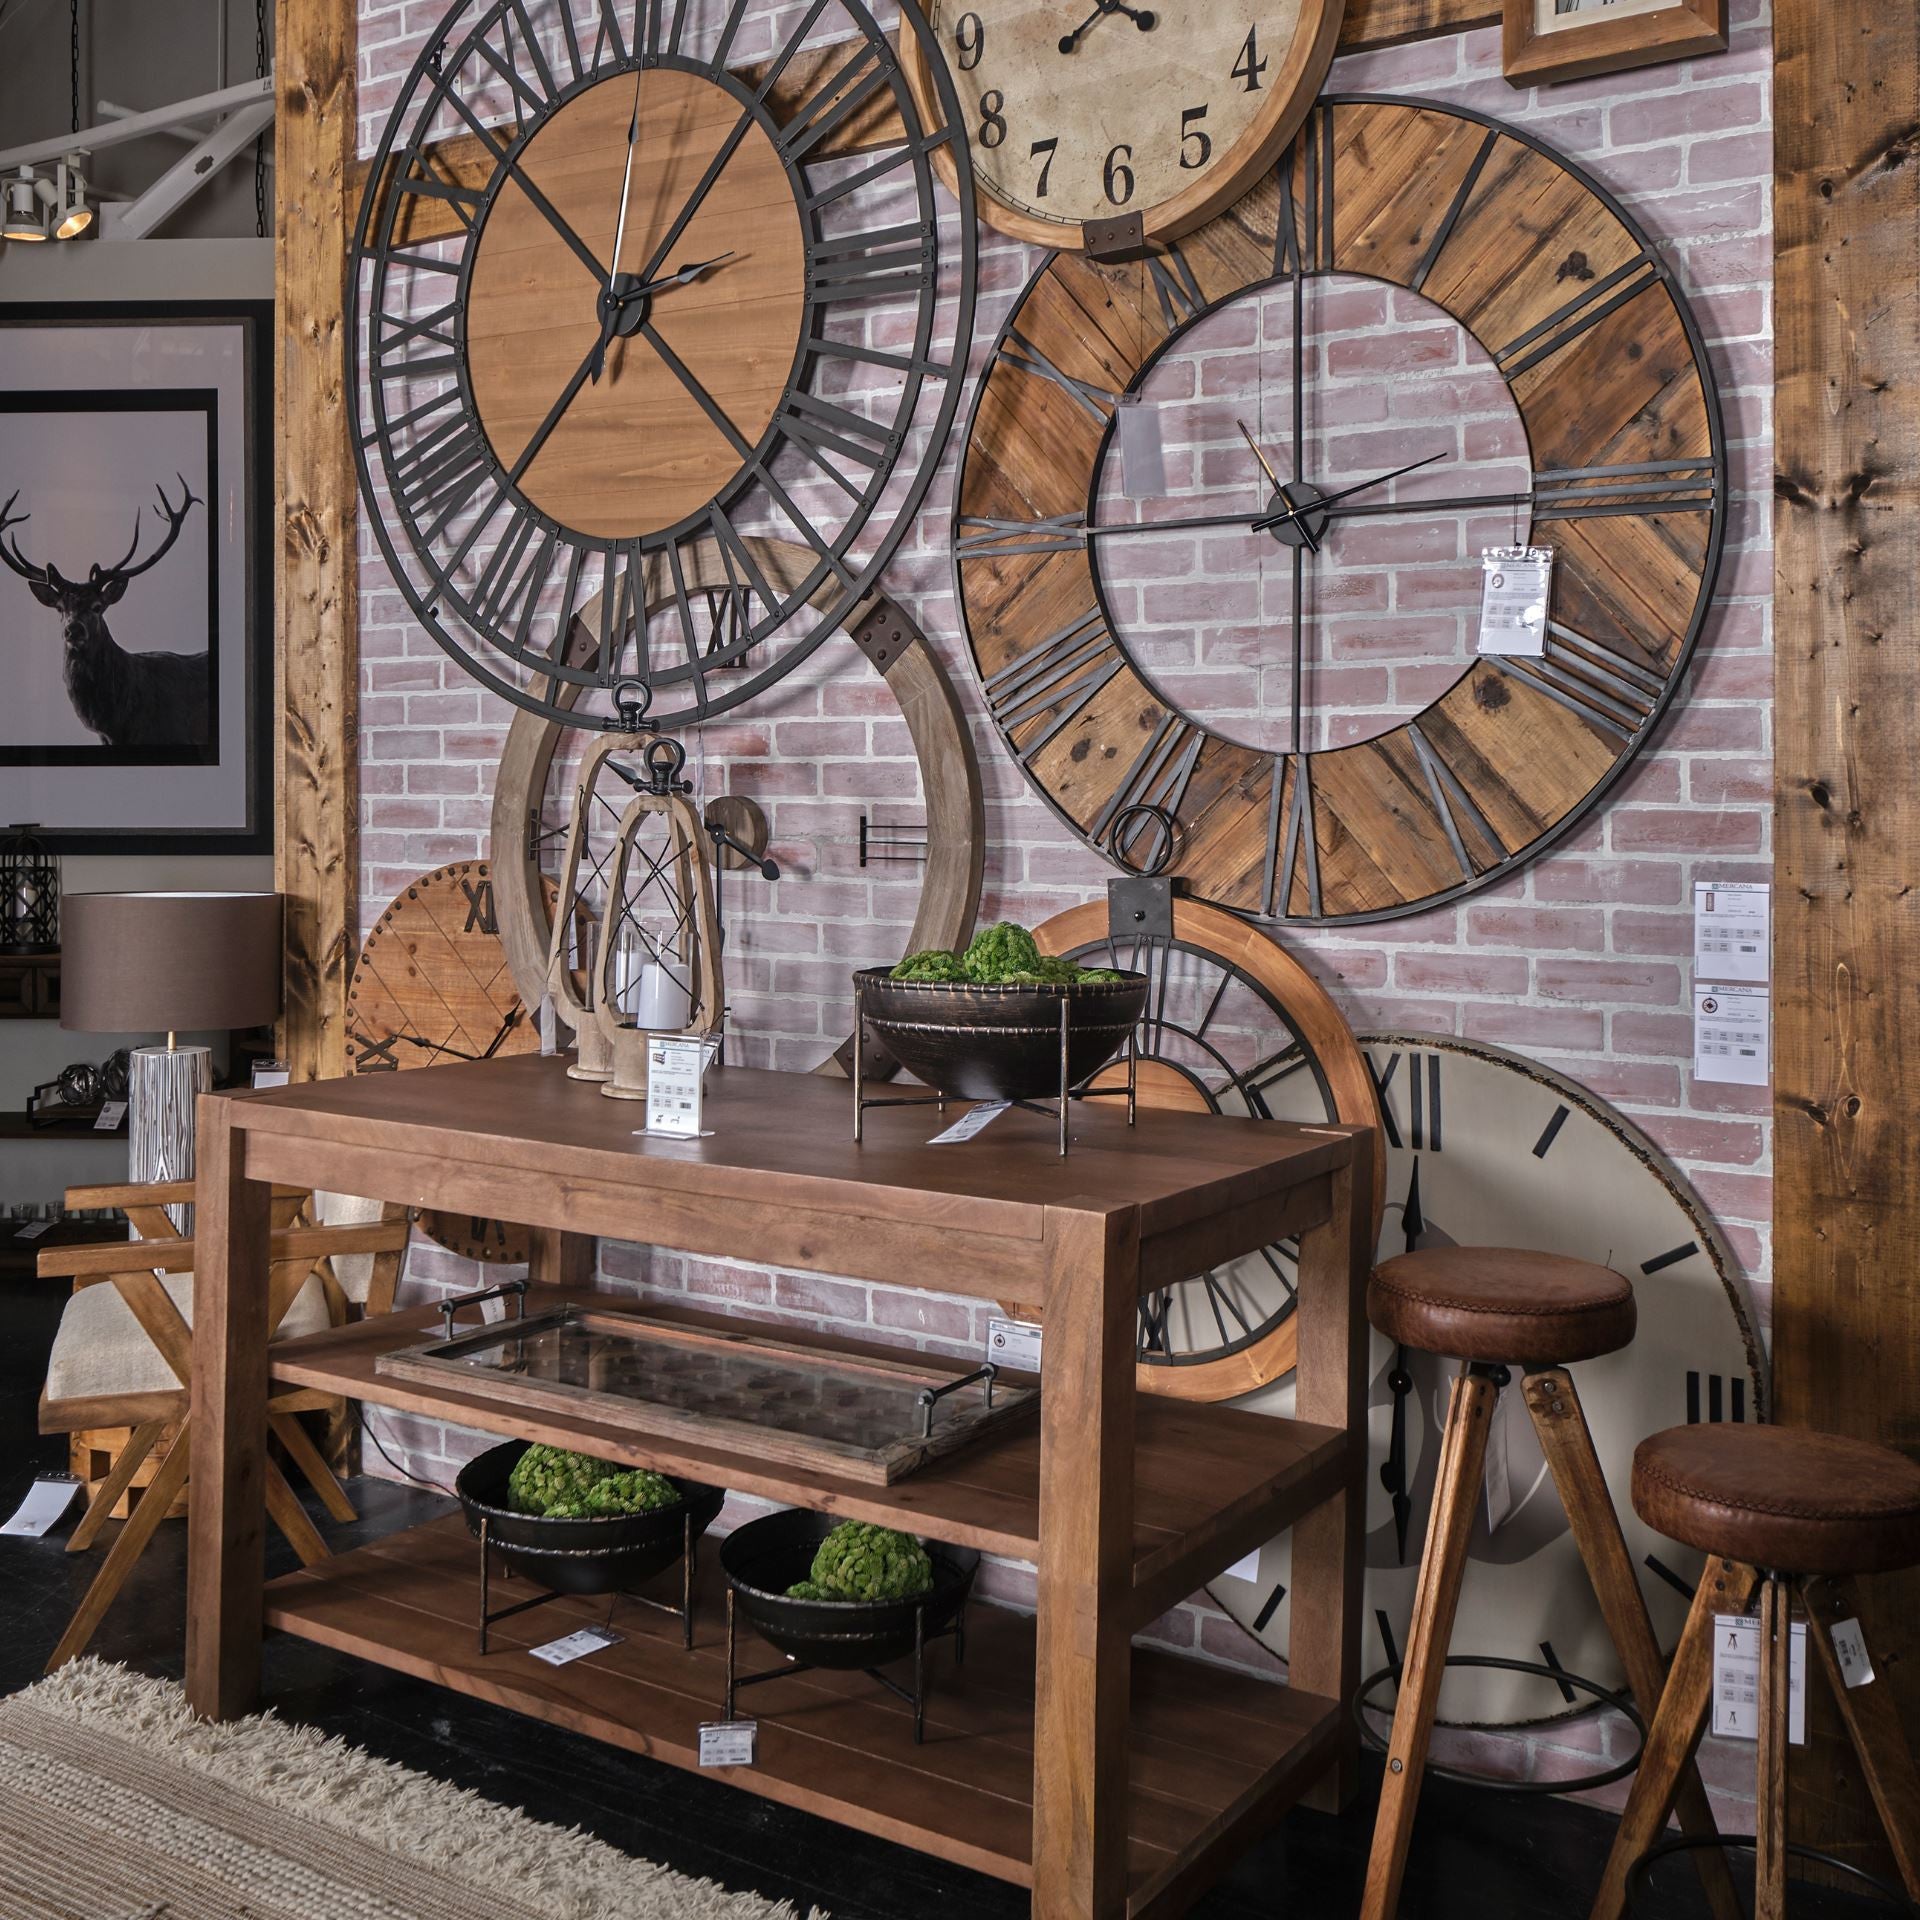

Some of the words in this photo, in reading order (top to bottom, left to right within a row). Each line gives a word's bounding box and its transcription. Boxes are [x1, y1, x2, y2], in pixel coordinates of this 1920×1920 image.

[955, 11, 985, 71] 9
[1230, 22, 1269, 93] 4
[978, 89, 1008, 149] 8
[1179, 103, 1212, 169] 5
[1030, 136, 1059, 198] 7
[1103, 144, 1135, 206] 6
